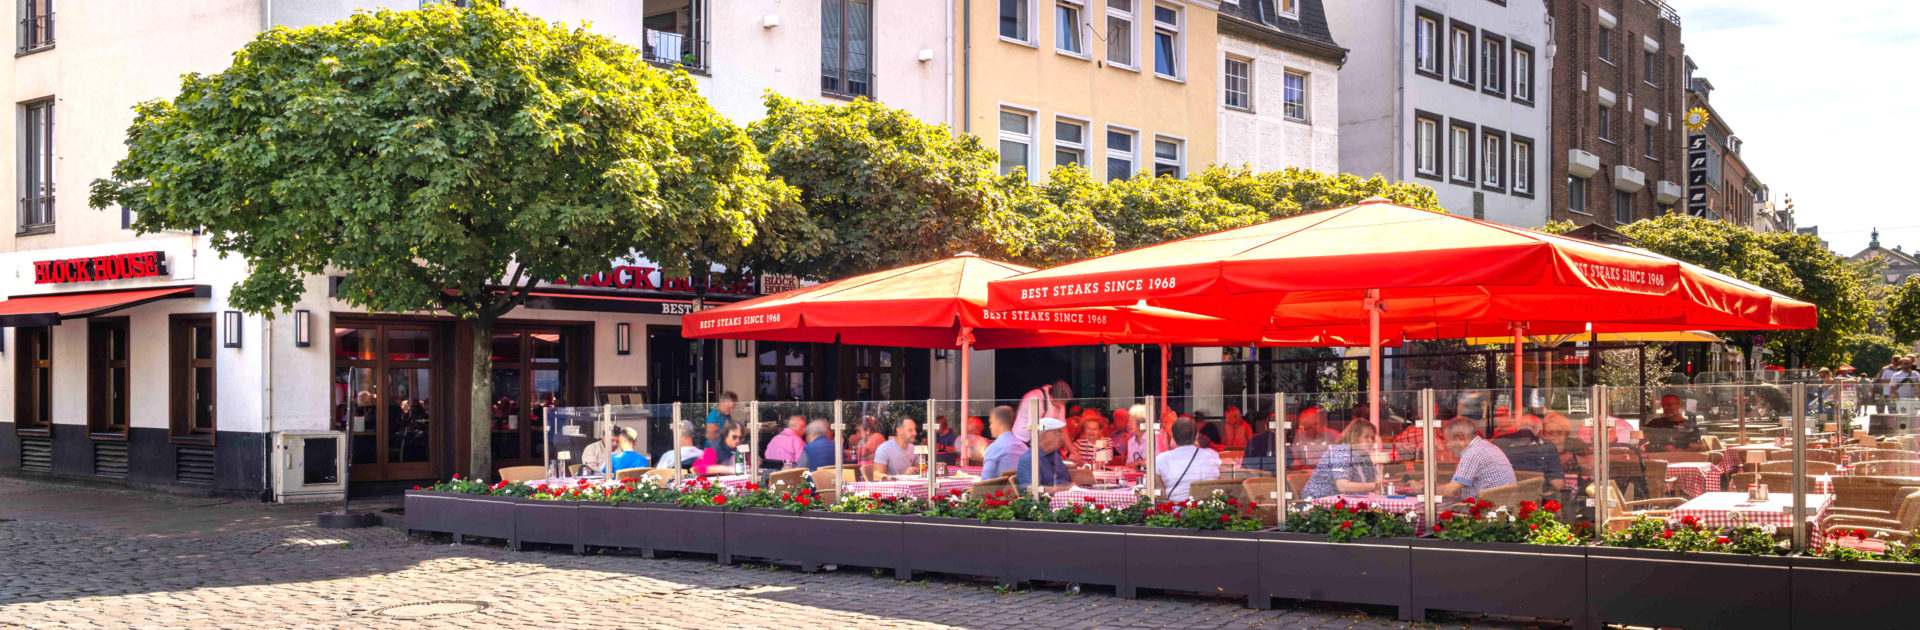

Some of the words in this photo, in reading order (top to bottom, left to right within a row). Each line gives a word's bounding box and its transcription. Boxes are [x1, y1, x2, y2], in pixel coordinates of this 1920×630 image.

[33, 257, 91, 284] BLOCK
[92, 251, 159, 280] HOUSE
[1575, 262, 1588, 276] EST
[1591, 264, 1620, 280] STEAKS
[1622, 269, 1646, 283] SINCE
[1648, 272, 1665, 286] 1968
[555, 265, 656, 290] OCK
[764, 276, 796, 286] BLOCK
[1020, 286, 1049, 300] BEST
[1053, 282, 1099, 297] STEAKS
[1104, 279, 1143, 293] SINCE
[1148, 277, 1176, 290] 1968
[662, 303, 692, 315] BEST
[983, 309, 1008, 320] BEST
[1011, 310, 1050, 322] STEAKS
[1054, 312, 1084, 323] SINCE
[1087, 314, 1107, 325] 1968
[700, 319, 715, 329] BEST
[717, 316, 742, 327] STEAKS
[744, 314, 764, 325] SINCE
[766, 313, 781, 323] 1968
